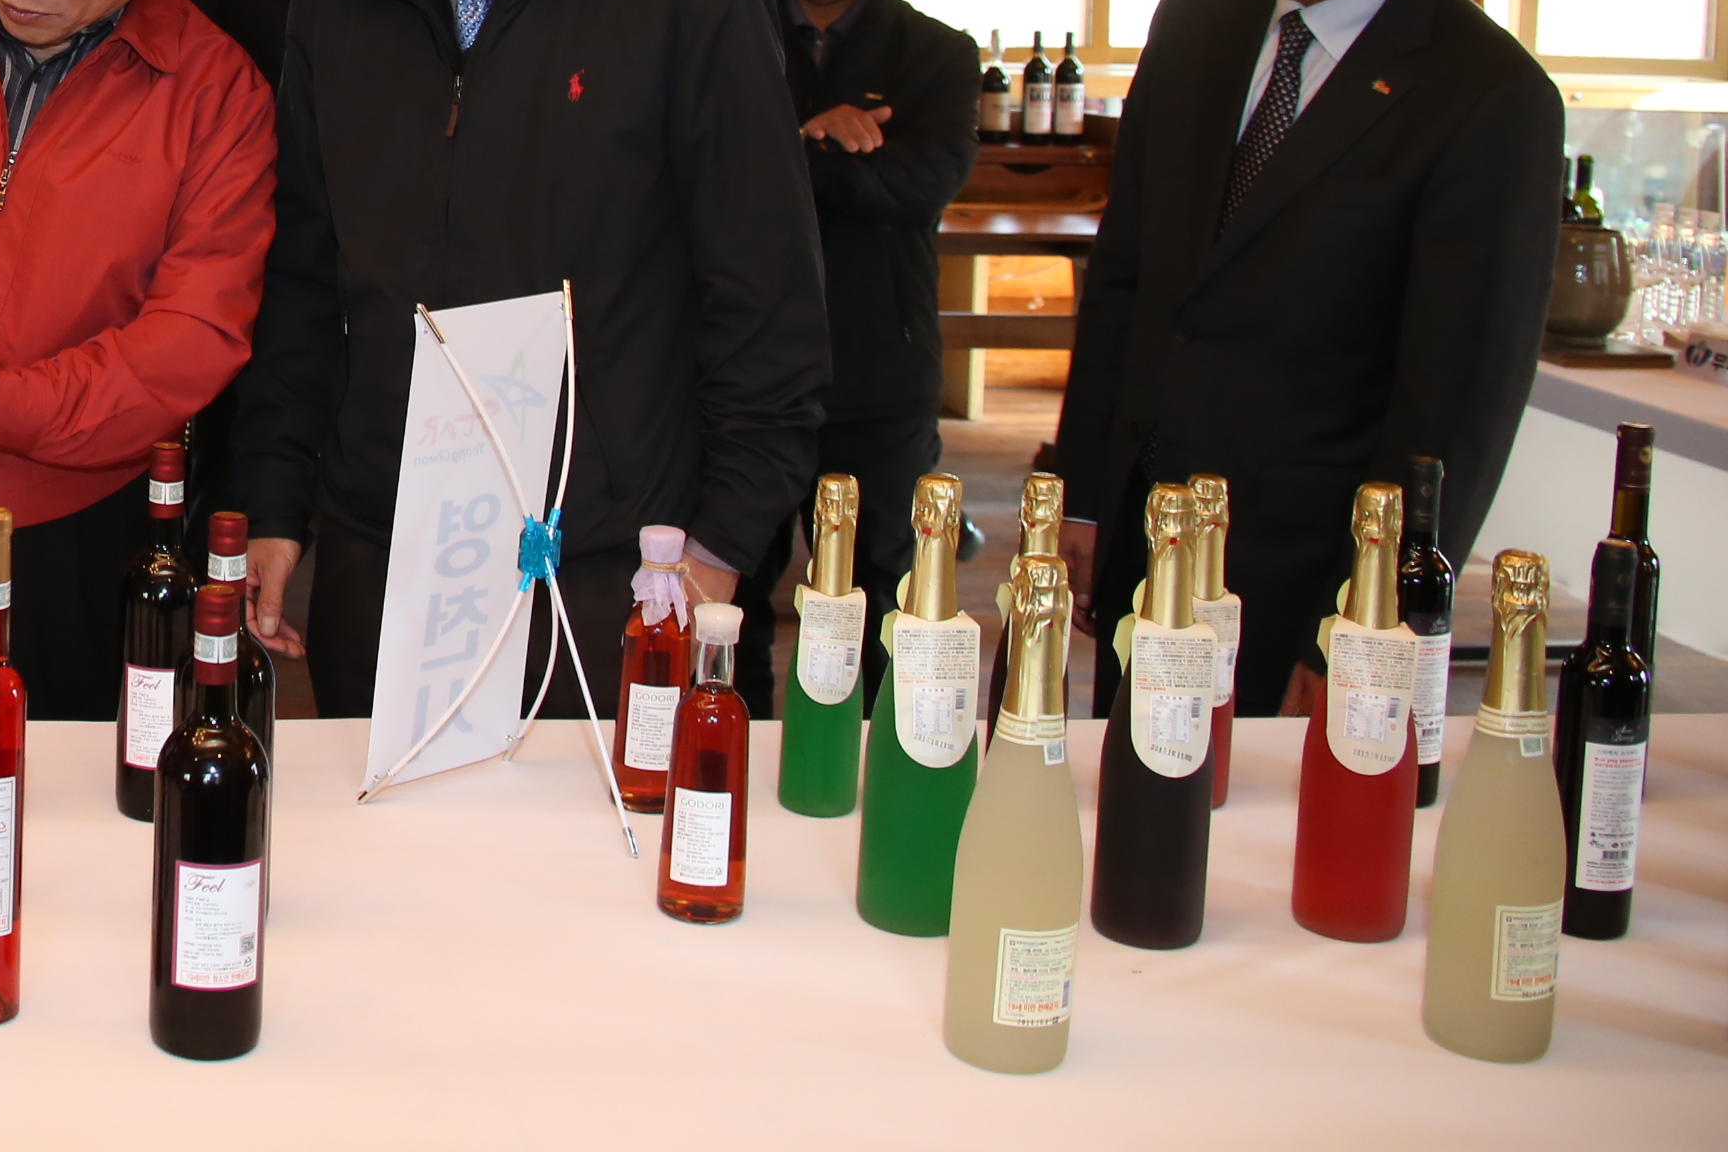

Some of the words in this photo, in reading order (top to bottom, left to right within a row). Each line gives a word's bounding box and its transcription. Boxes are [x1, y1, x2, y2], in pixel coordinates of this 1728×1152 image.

[130, 672, 162, 691] Feel
[635, 692, 675, 703] GODORI
[680, 797, 725, 810] GODORI
[183, 872, 226, 893] Feel
[187, 973, 211, 983] 19세미만
[213, 974, 229, 983] 청소년
[231, 972, 249, 982] 판매금지
[1506, 978, 1520, 987] 19세
[1008, 1002, 1022, 1012] 19세
[1023, 1003, 1036, 1013] 미만
[1038, 1001, 1059, 1012] 판매금지
